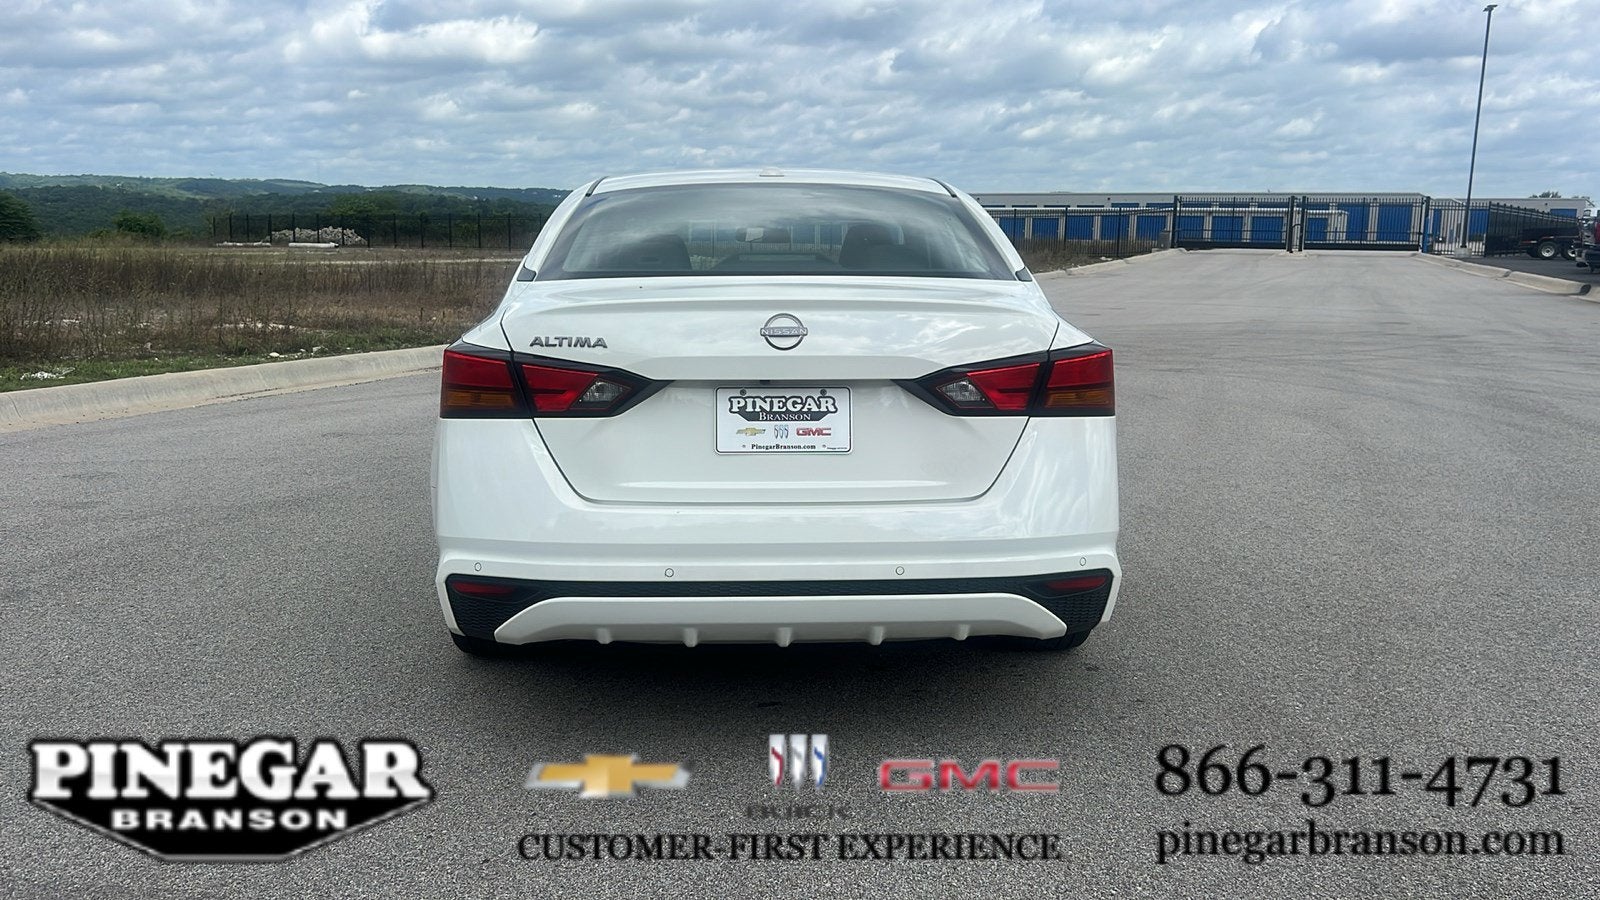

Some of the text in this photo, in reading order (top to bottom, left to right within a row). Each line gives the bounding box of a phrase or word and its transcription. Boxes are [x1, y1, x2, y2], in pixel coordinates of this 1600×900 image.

[761, 327, 807, 336] NISSAN
[530, 337, 608, 349] ALTIMA
[730, 396, 837, 413] PINEGAR
[759, 412, 811, 421] BRANSON
[796, 427, 832, 437] GMC
[751, 443, 816, 451] PinegarBranson.com
